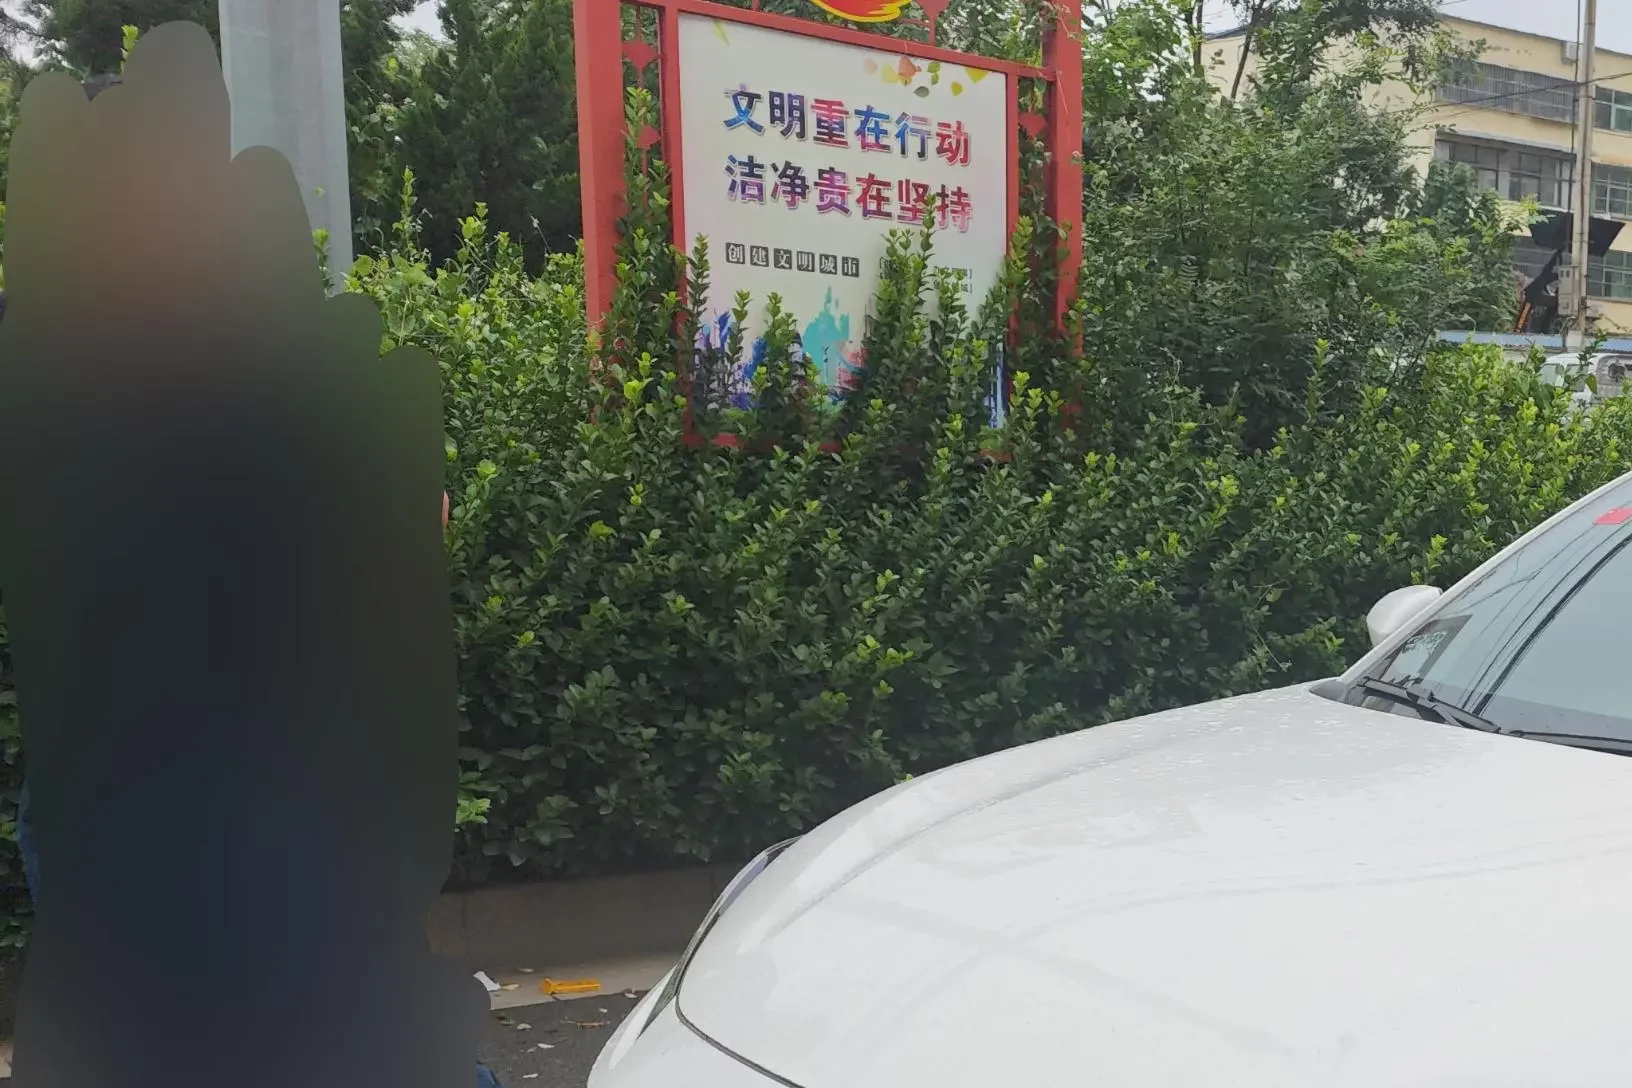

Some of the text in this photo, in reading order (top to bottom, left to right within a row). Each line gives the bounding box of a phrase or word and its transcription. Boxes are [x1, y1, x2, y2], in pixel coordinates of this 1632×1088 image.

[723, 84, 972, 167] 文明重在行动
[724, 155, 973, 232] 洁净贵在坚持
[726, 243, 860, 277] 创建文明城市
